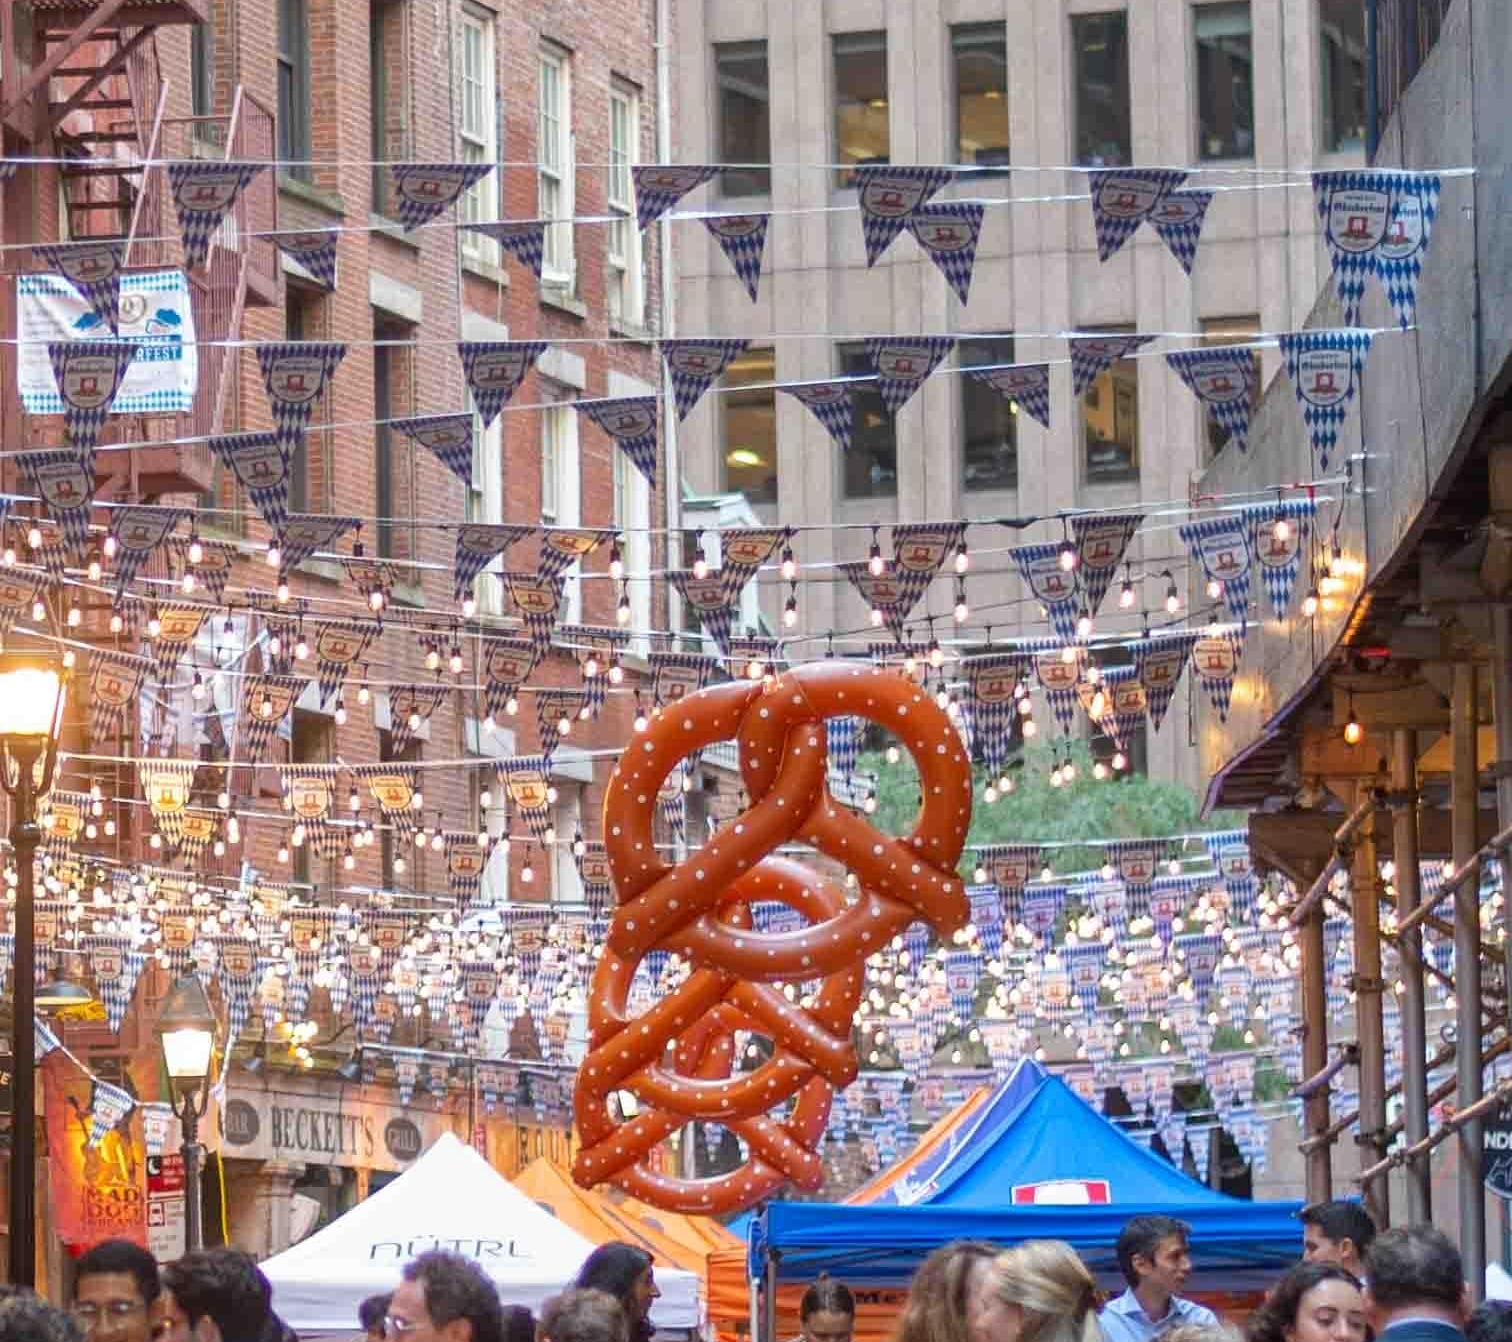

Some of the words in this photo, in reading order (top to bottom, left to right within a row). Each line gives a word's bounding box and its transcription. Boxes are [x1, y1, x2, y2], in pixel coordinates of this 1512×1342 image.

[271, 1107, 375, 1157] BECKETT'S
[86, 1188, 139, 1202] MAD
[87, 1204, 139, 1218] DOG
